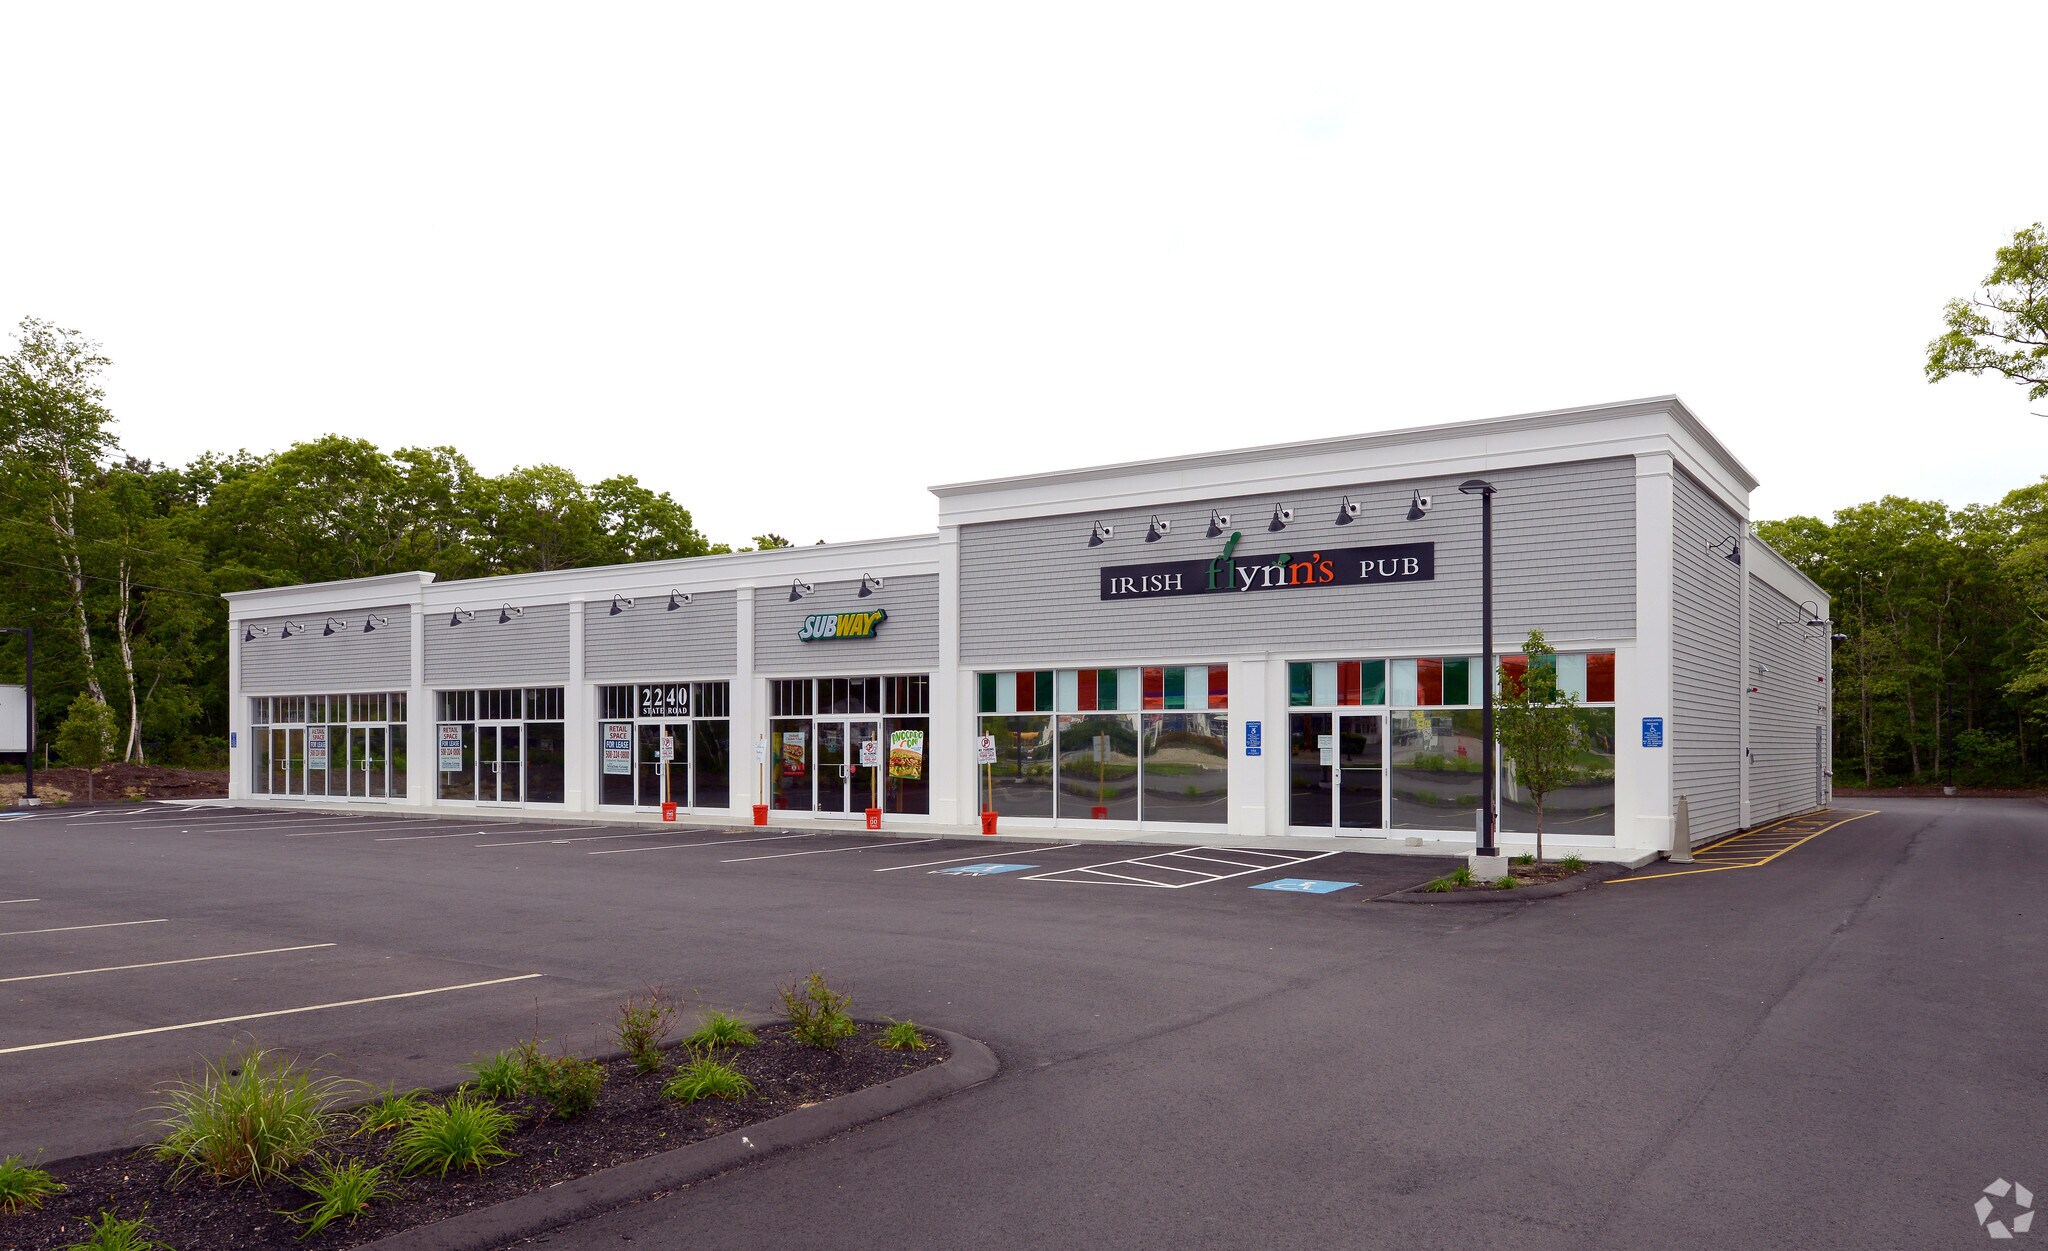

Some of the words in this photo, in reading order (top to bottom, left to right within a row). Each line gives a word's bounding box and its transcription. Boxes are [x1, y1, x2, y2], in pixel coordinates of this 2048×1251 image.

[1110, 573, 1183, 595] IRISH
[1359, 557, 1420, 578] PUB
[799, 611, 882, 639] SUBWAY
[642, 687, 688, 706] 2240
[642, 707, 665, 715] STATE
[667, 706, 688, 715] ROAD
[606, 741, 615, 749] FOR
[615, 741, 629, 749] LEASE
[891, 731, 923, 745] AVOCADO
